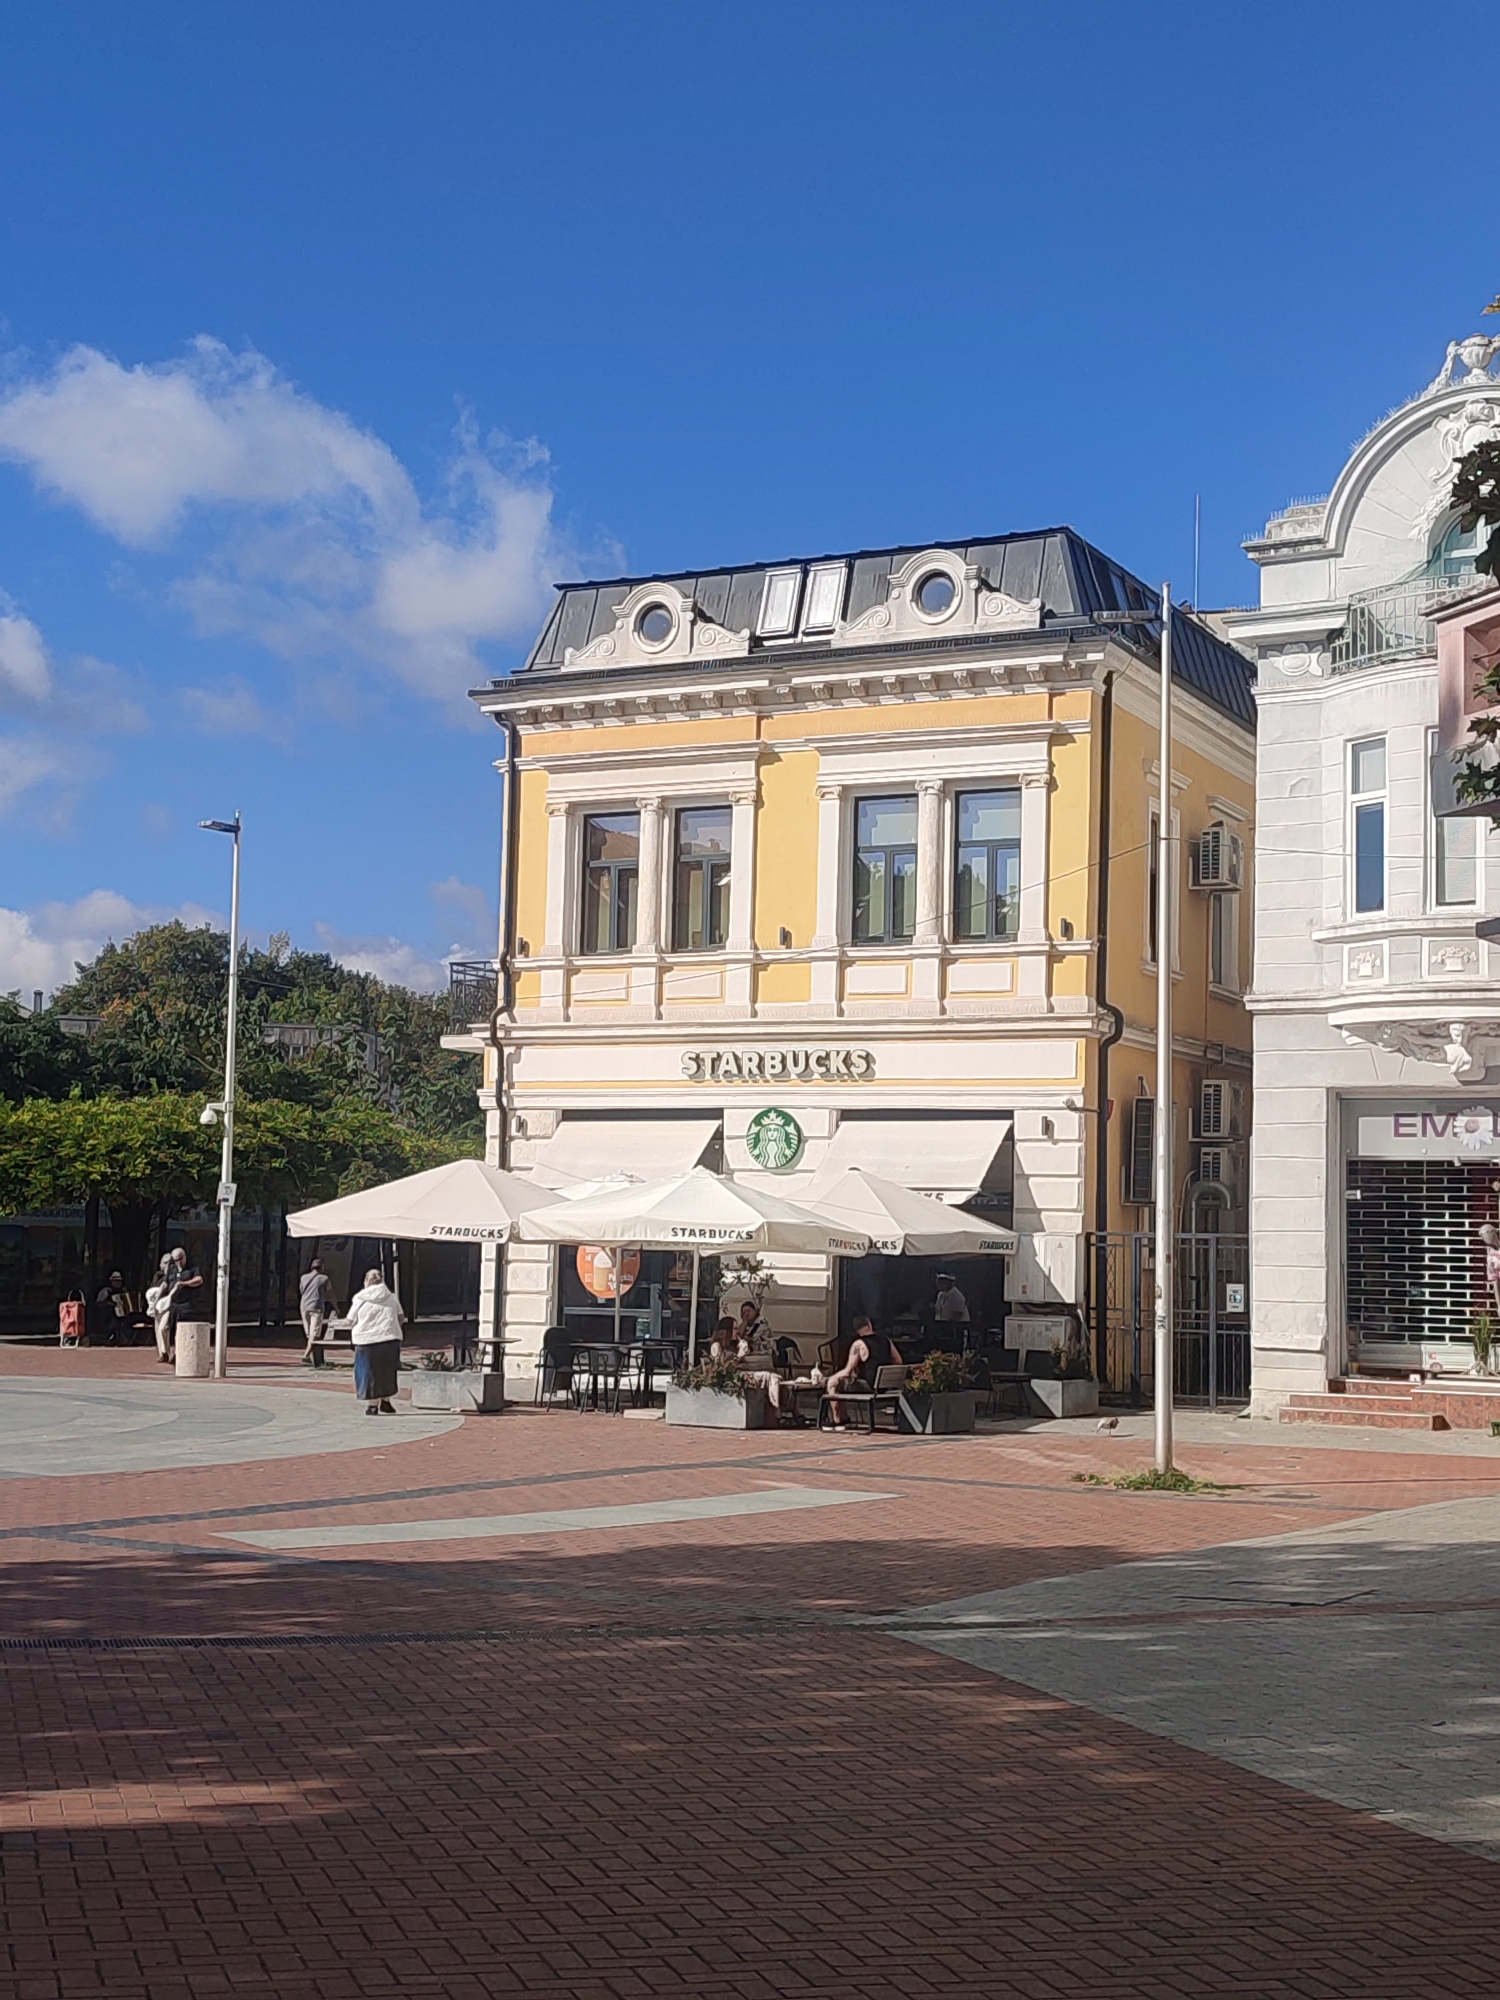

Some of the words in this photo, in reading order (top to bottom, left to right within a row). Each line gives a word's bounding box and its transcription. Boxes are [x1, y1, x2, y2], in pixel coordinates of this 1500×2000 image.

[681, 1050, 873, 1076] STARBUCKS
[430, 1226, 504, 1239] STARBUCKS
[671, 1227, 754, 1240] STARBUCKS
[828, 1238, 867, 1251] STARBUCKS
[979, 1240, 1014, 1250] STARBUCKS
